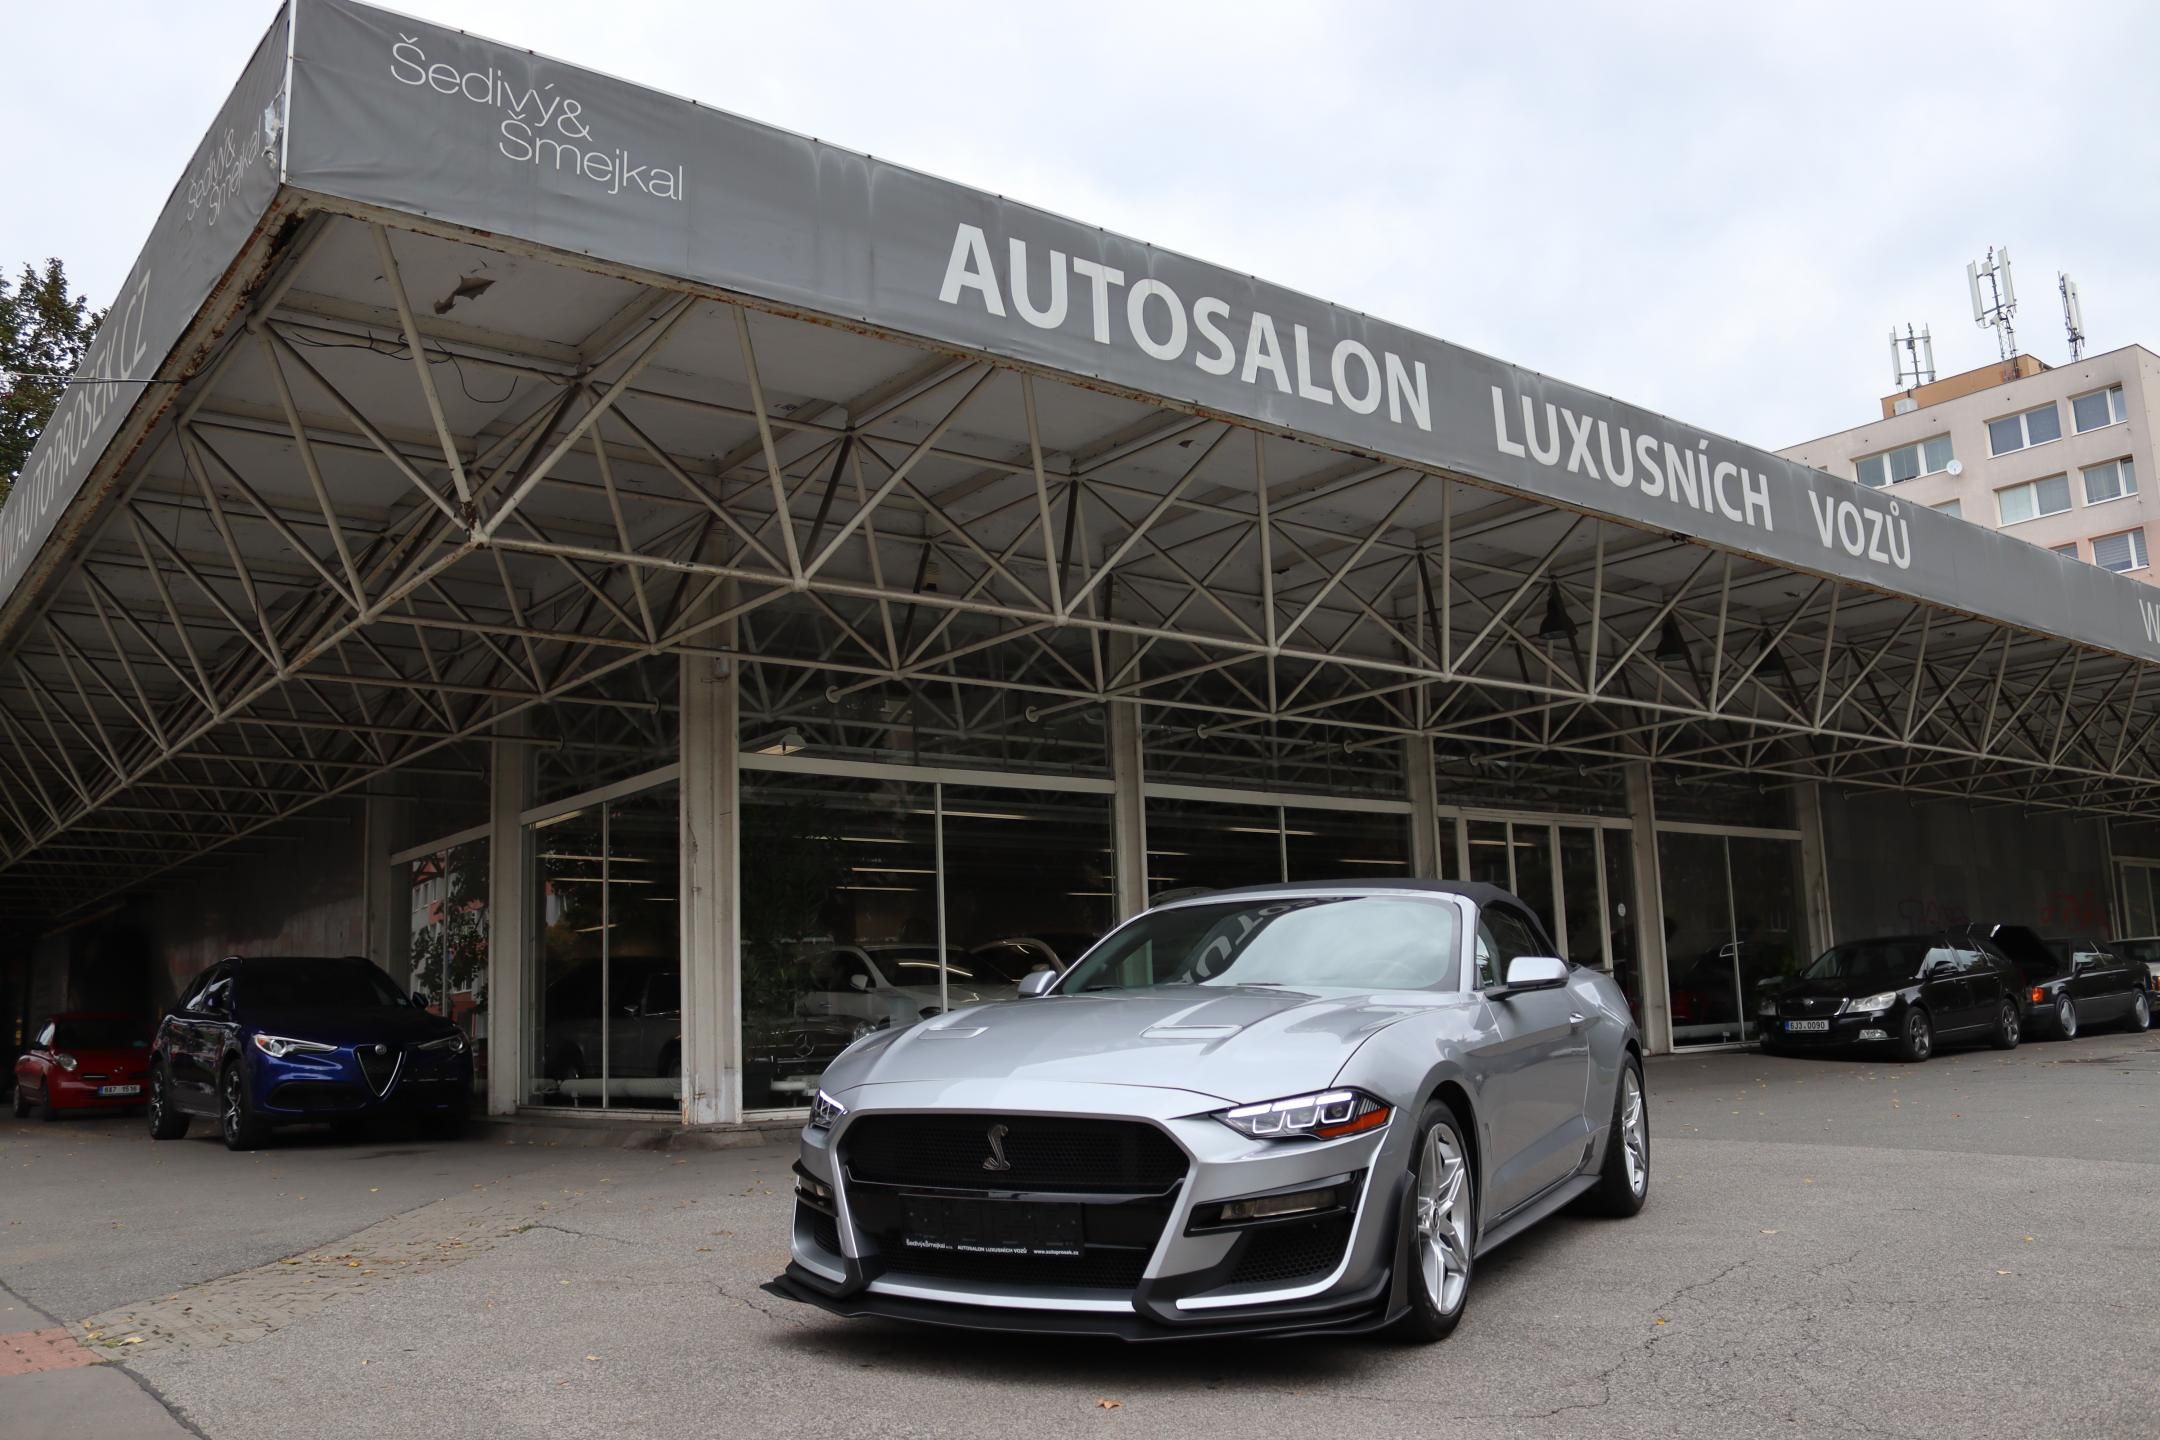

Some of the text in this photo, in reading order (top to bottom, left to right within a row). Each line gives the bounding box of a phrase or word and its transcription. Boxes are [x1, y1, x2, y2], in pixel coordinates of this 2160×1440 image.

[391, 32, 592, 141] Šedivý&
[499, 109, 683, 200] Šmejkal
[938, 222, 1911, 570] AUTOSALON LUXUSNÍCH VOZŮ
